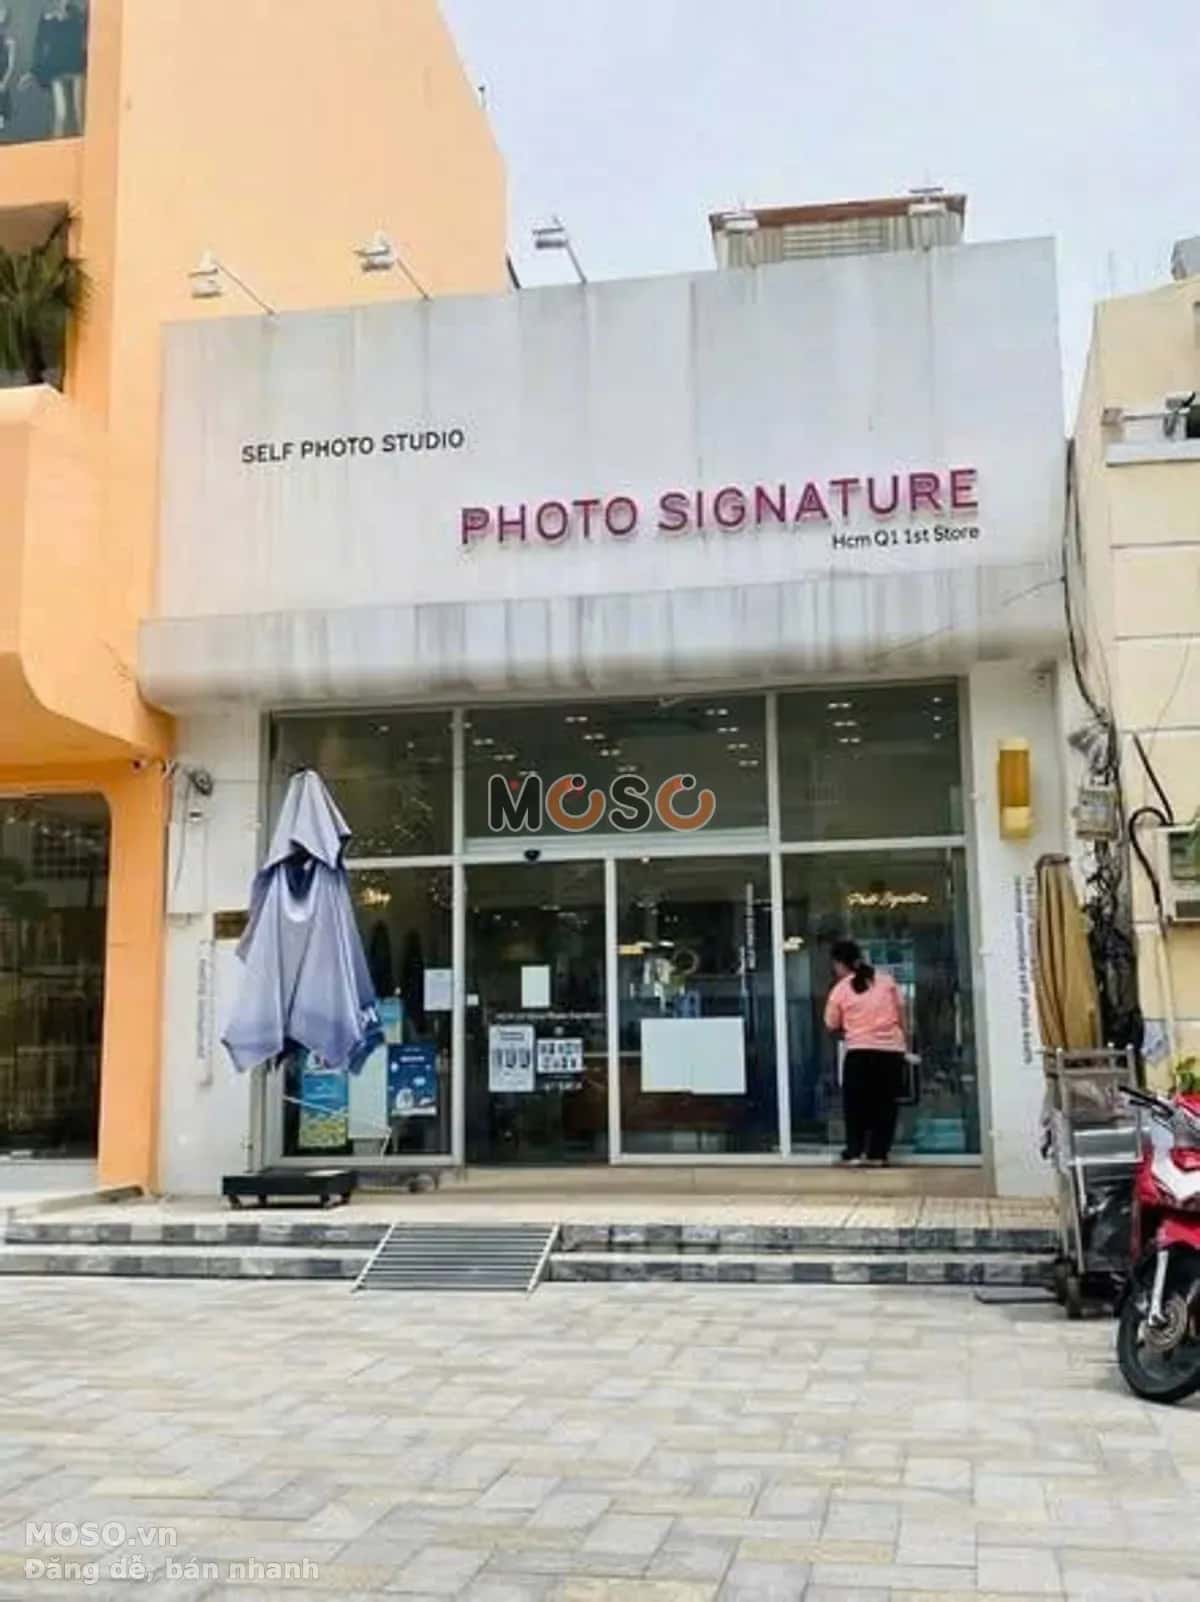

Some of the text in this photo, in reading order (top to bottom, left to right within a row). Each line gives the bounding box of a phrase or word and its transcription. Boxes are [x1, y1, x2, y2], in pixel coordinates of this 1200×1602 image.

[241, 429, 465, 463] SELF PHOTO STUDIO
[461, 469, 979, 545] PHOTO SIGNATURE
[832, 525, 980, 549] Hcm Q1 1st Store
